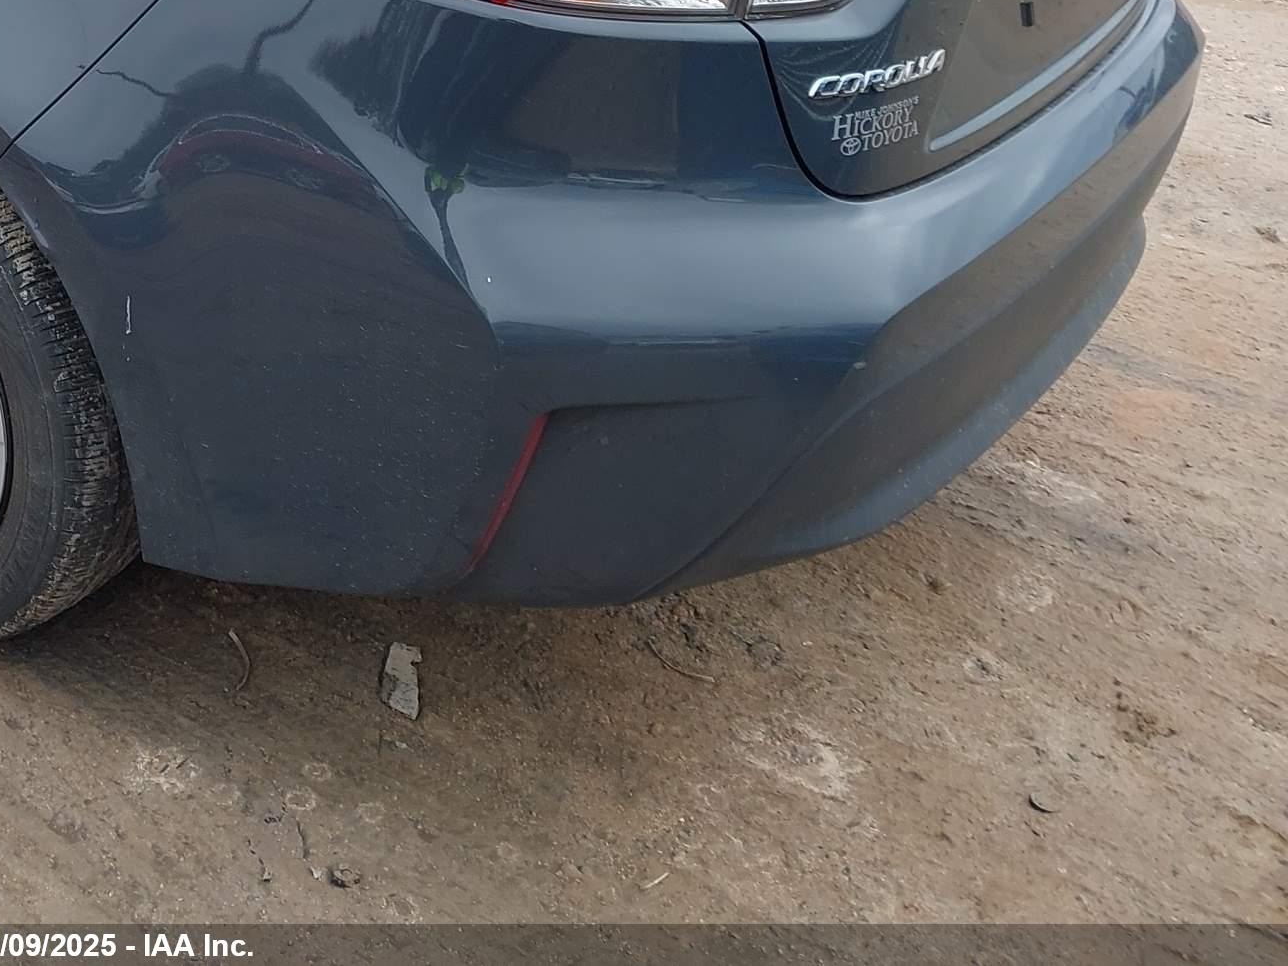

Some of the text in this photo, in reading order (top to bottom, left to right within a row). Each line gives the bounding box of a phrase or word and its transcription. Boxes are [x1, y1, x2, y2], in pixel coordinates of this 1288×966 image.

[808, 48, 946, 99] COROLLA
[831, 105, 914, 141] HICKORY
[861, 120, 920, 151] TOYOTA
